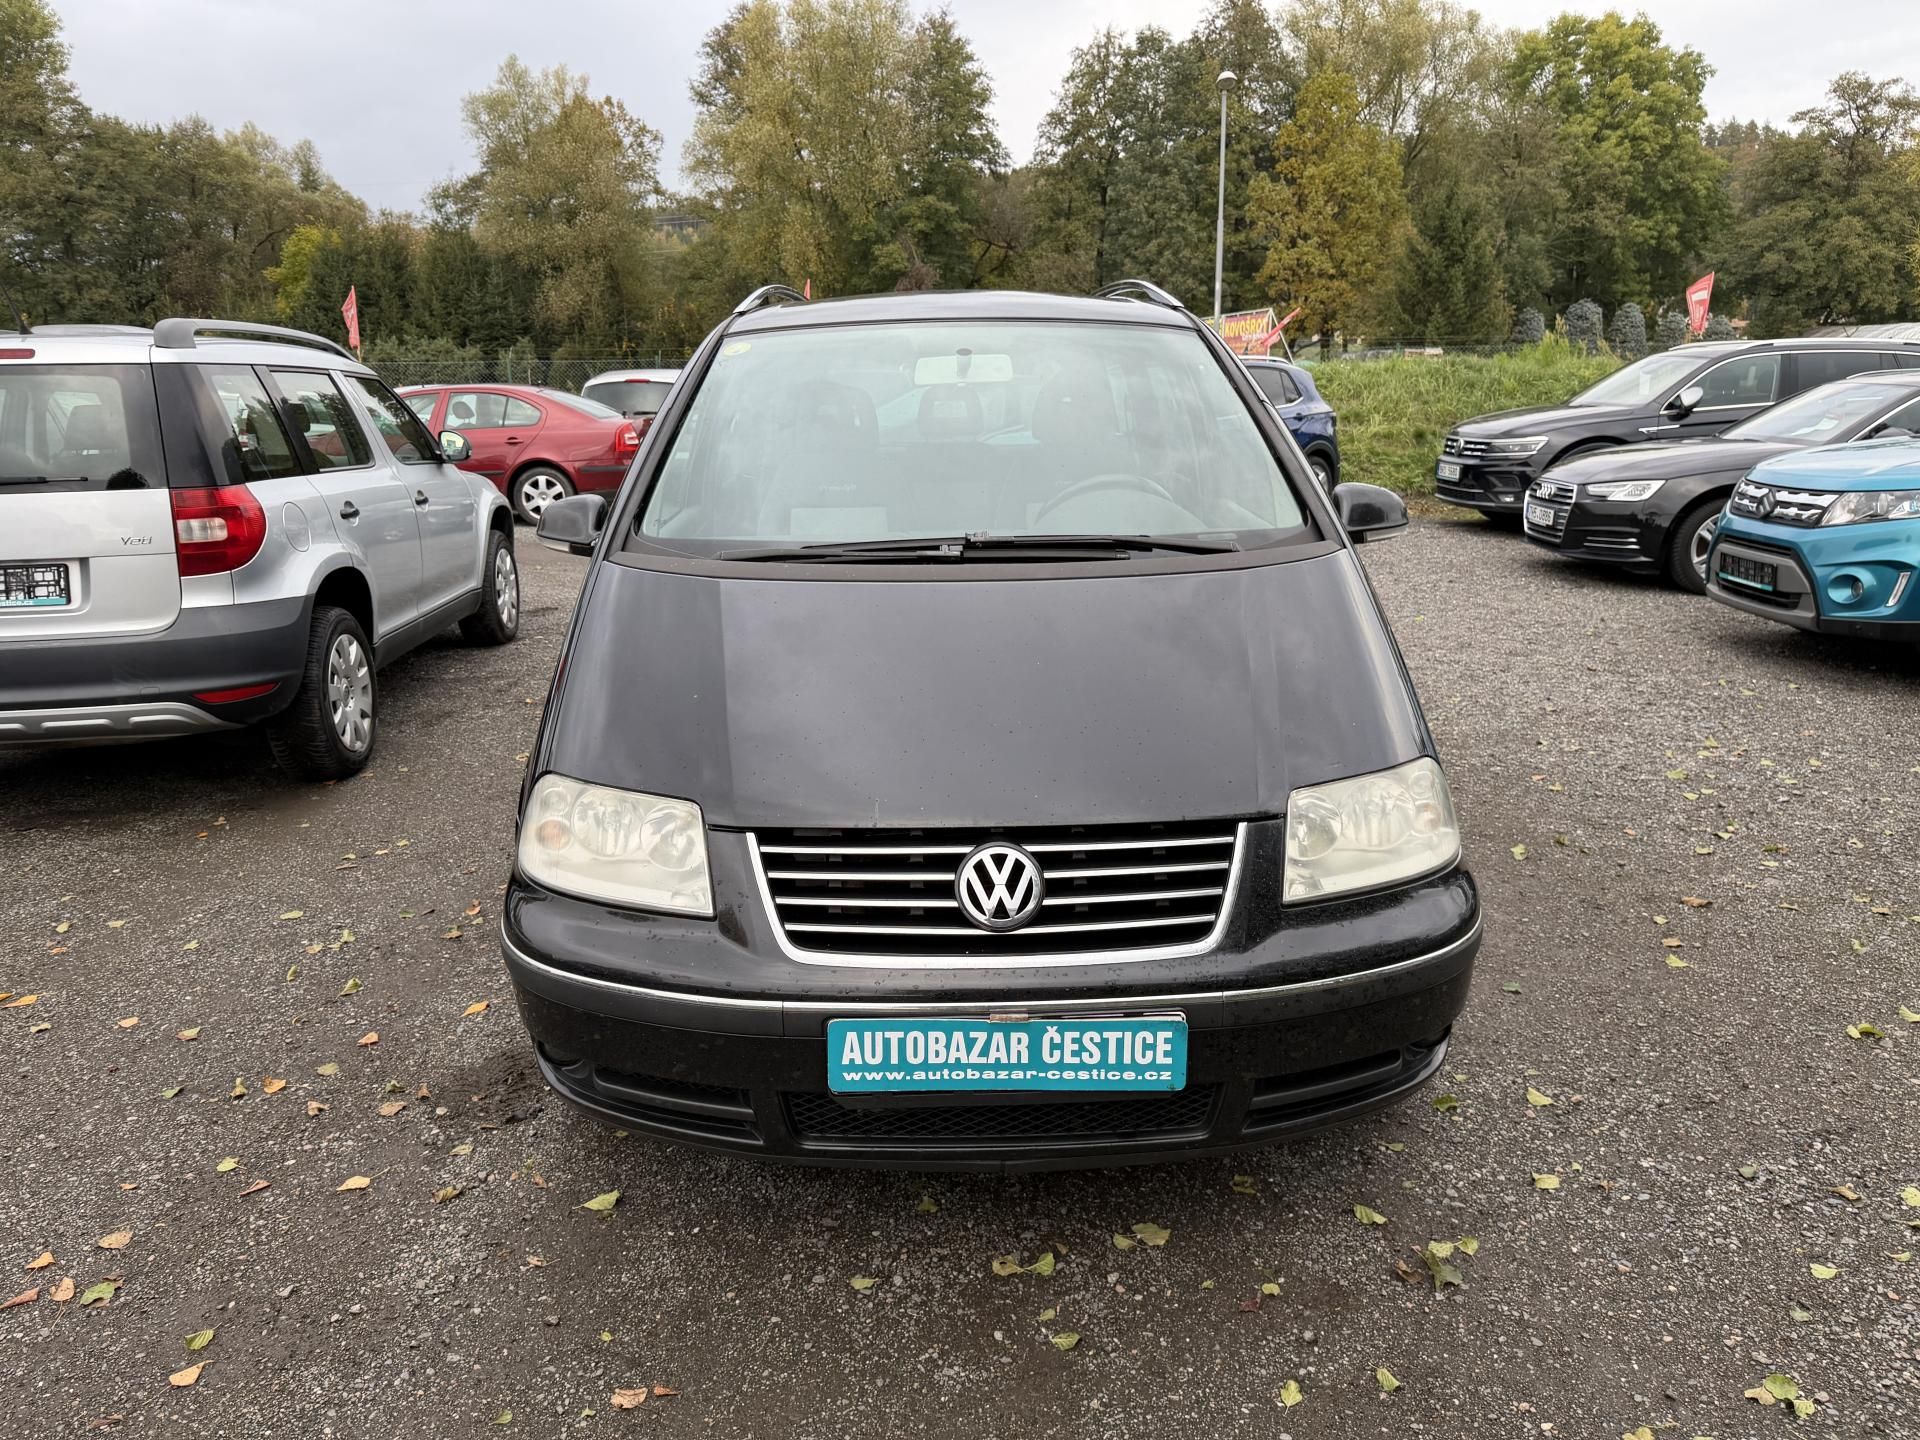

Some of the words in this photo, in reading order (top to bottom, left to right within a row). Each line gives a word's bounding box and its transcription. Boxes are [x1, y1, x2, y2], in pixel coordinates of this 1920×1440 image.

[1225, 316, 1267, 337] KOVOŠROT
[121, 536, 153, 546] Yeti
[841, 1030, 1029, 1065] AUTOBAZAR
[1042, 1026, 1173, 1065] ČESTICE
[842, 1068, 1172, 1081] www.autobazar-cestice.cz
